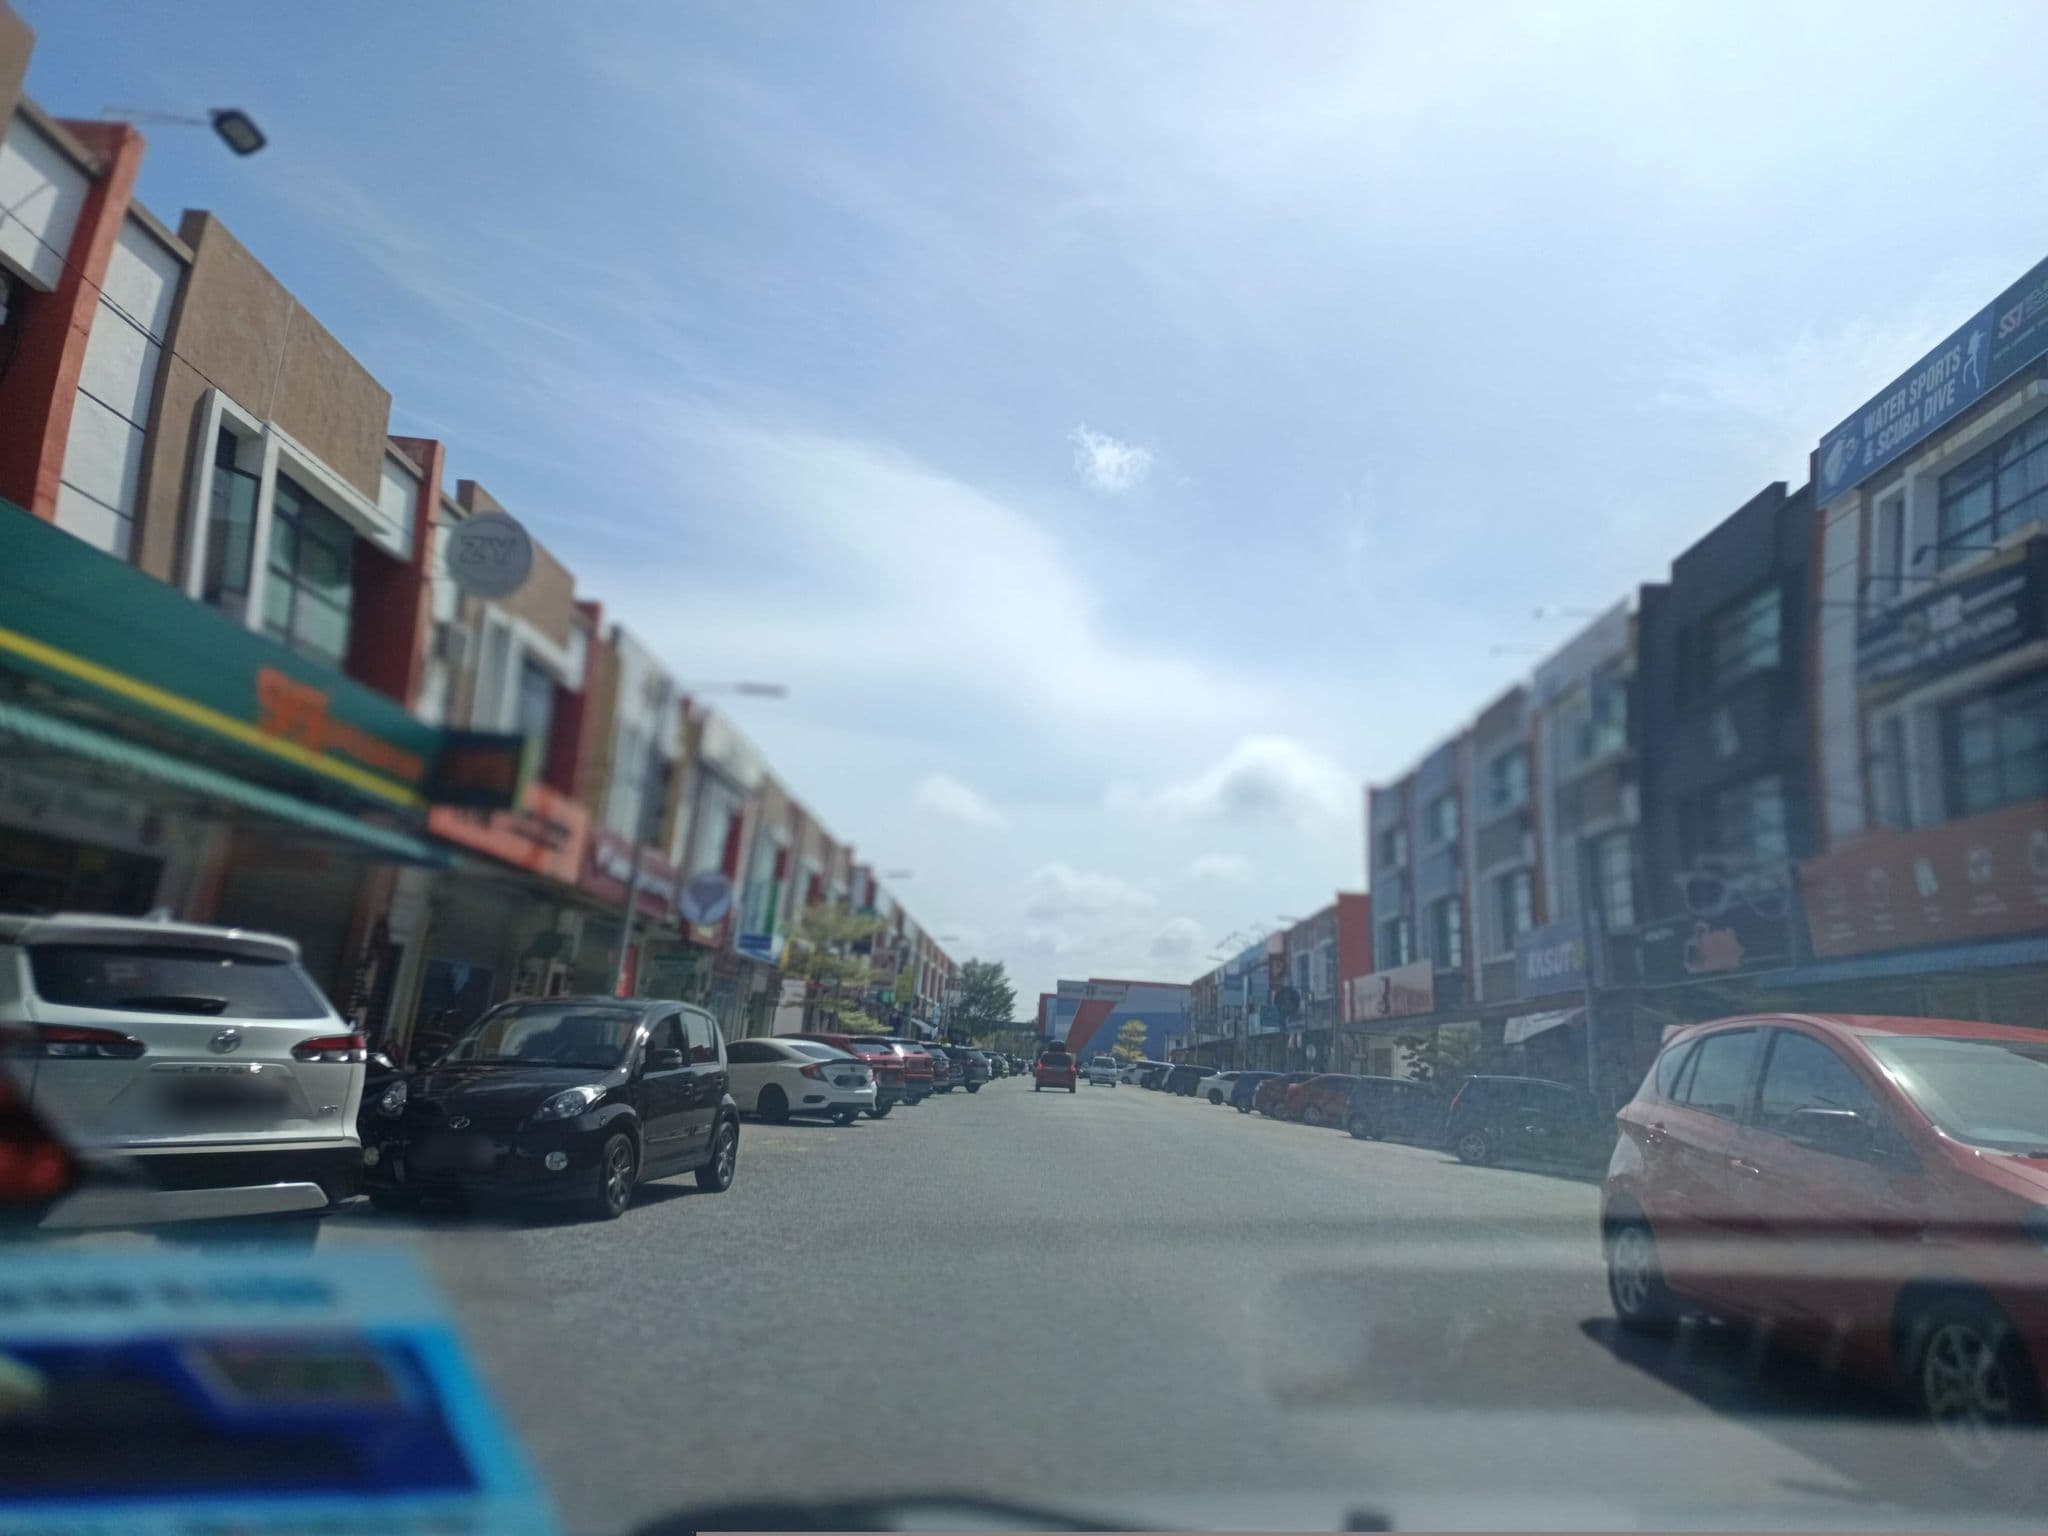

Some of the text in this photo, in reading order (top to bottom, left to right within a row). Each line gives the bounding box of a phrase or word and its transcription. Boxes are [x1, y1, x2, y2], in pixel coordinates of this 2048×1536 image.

[1864, 344, 1960, 439] WATER SPORTS
[1876, 405, 1920, 456] SCUBA
[1924, 378, 1955, 424] DIVE
